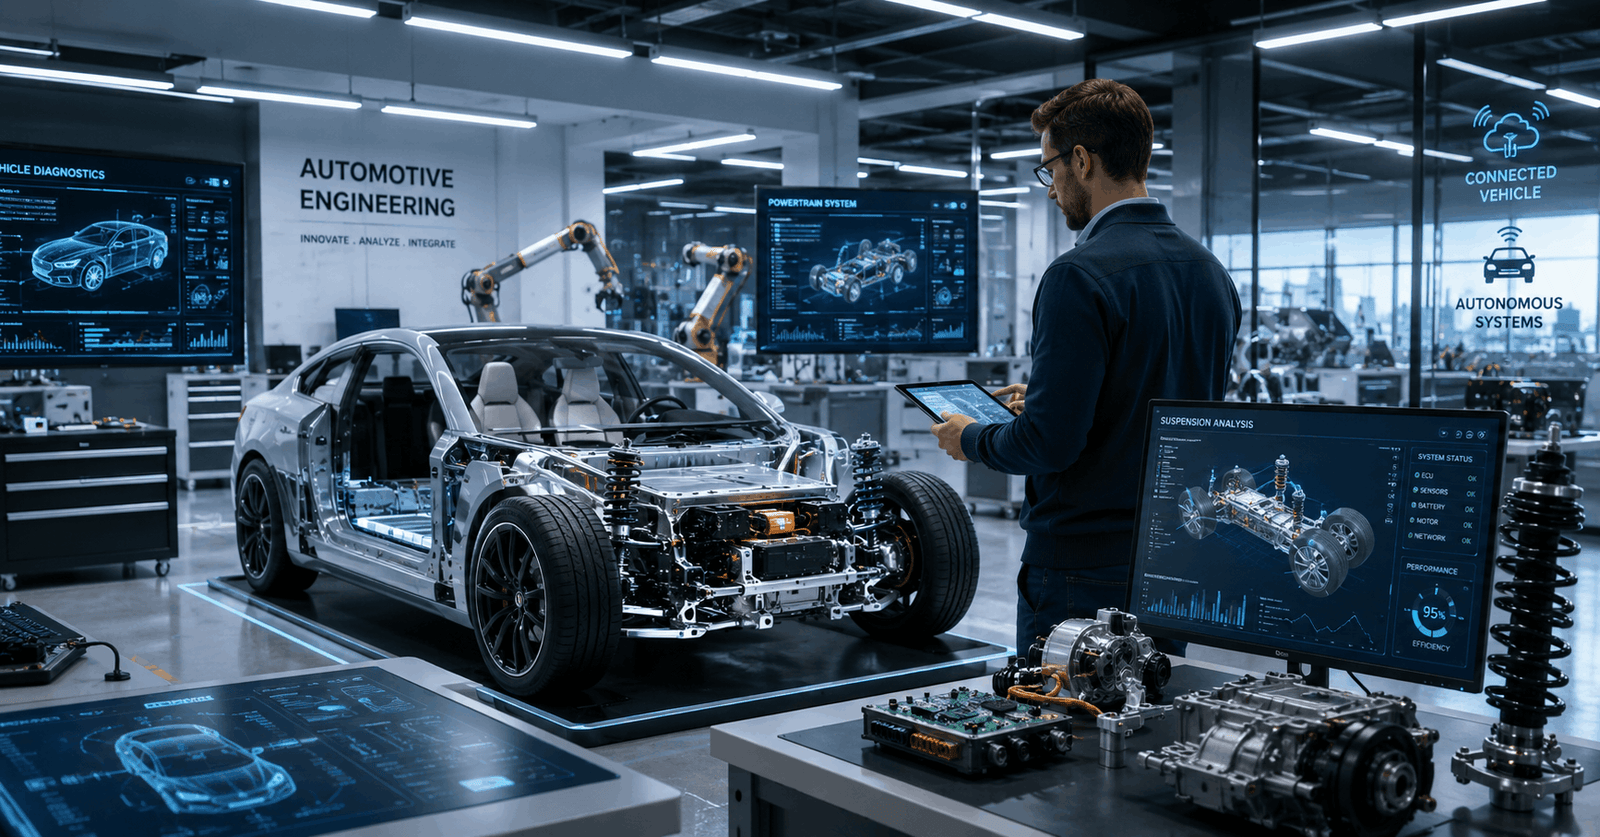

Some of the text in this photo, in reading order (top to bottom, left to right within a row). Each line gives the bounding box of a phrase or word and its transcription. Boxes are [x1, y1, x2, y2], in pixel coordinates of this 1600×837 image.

[34, 166, 105, 180] DIAGNOSTICS
[300, 158, 454, 188] AUTOMOTIVE
[1465, 165, 1557, 185] CONNECTED
[1480, 186, 1541, 202] VEHICLE
[300, 189, 455, 217] ENGINEERING
[768, 198, 857, 208] POWERTRAIN SYSTEM
[300, 234, 349, 244] INNOVATE
[359, 236, 400, 246] ANALYZE
[408, 238, 456, 248] INTEGRATE
[1456, 297, 1563, 310] AUTONOMOUS
[1476, 316, 1543, 328] SYSTEMS
[1160, 416, 1254, 429] SUSPENSION ANALYSIS
[1418, 453, 1473, 463] SYSTEM STATUS
[1419, 487, 1448, 496] SENSORS
[1418, 502, 1446, 510] BATTERY
[1416, 518, 1439, 526] MOTOR
[1414, 533, 1446, 542] NETWORK
[1406, 563, 1458, 576] PERFORMANCE
[1423, 606, 1446, 620] 95%
[1412, 639, 1450, 652] EFFICIENCY
